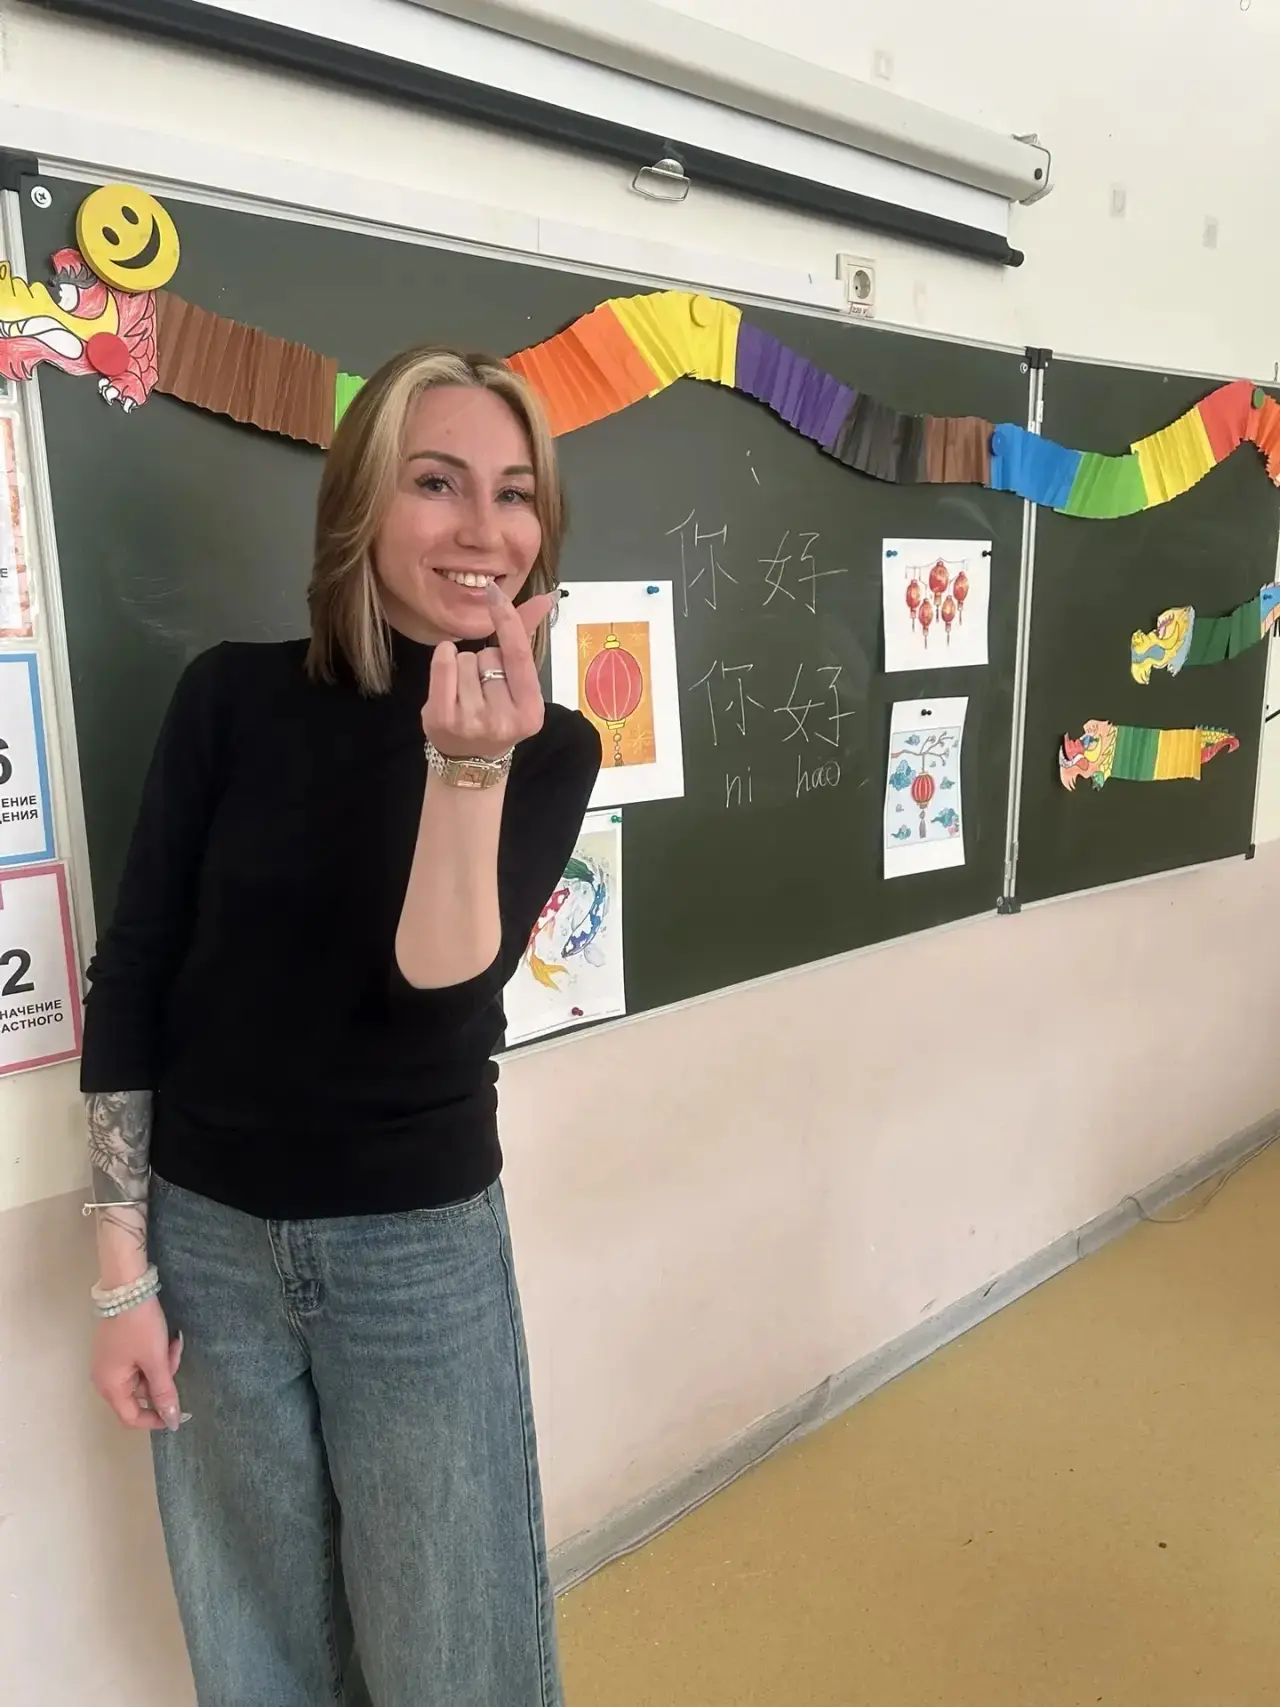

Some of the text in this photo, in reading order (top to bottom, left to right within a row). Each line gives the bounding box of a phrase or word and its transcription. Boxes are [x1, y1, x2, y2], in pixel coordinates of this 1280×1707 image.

[726, 754, 840, 808] ni hao
[0, 809, 38, 824] ЕНИЯ
[0, 1000, 62, 1019] НАЧЕНИЕ
[1, 1013, 63, 1034] АСТНОГО
